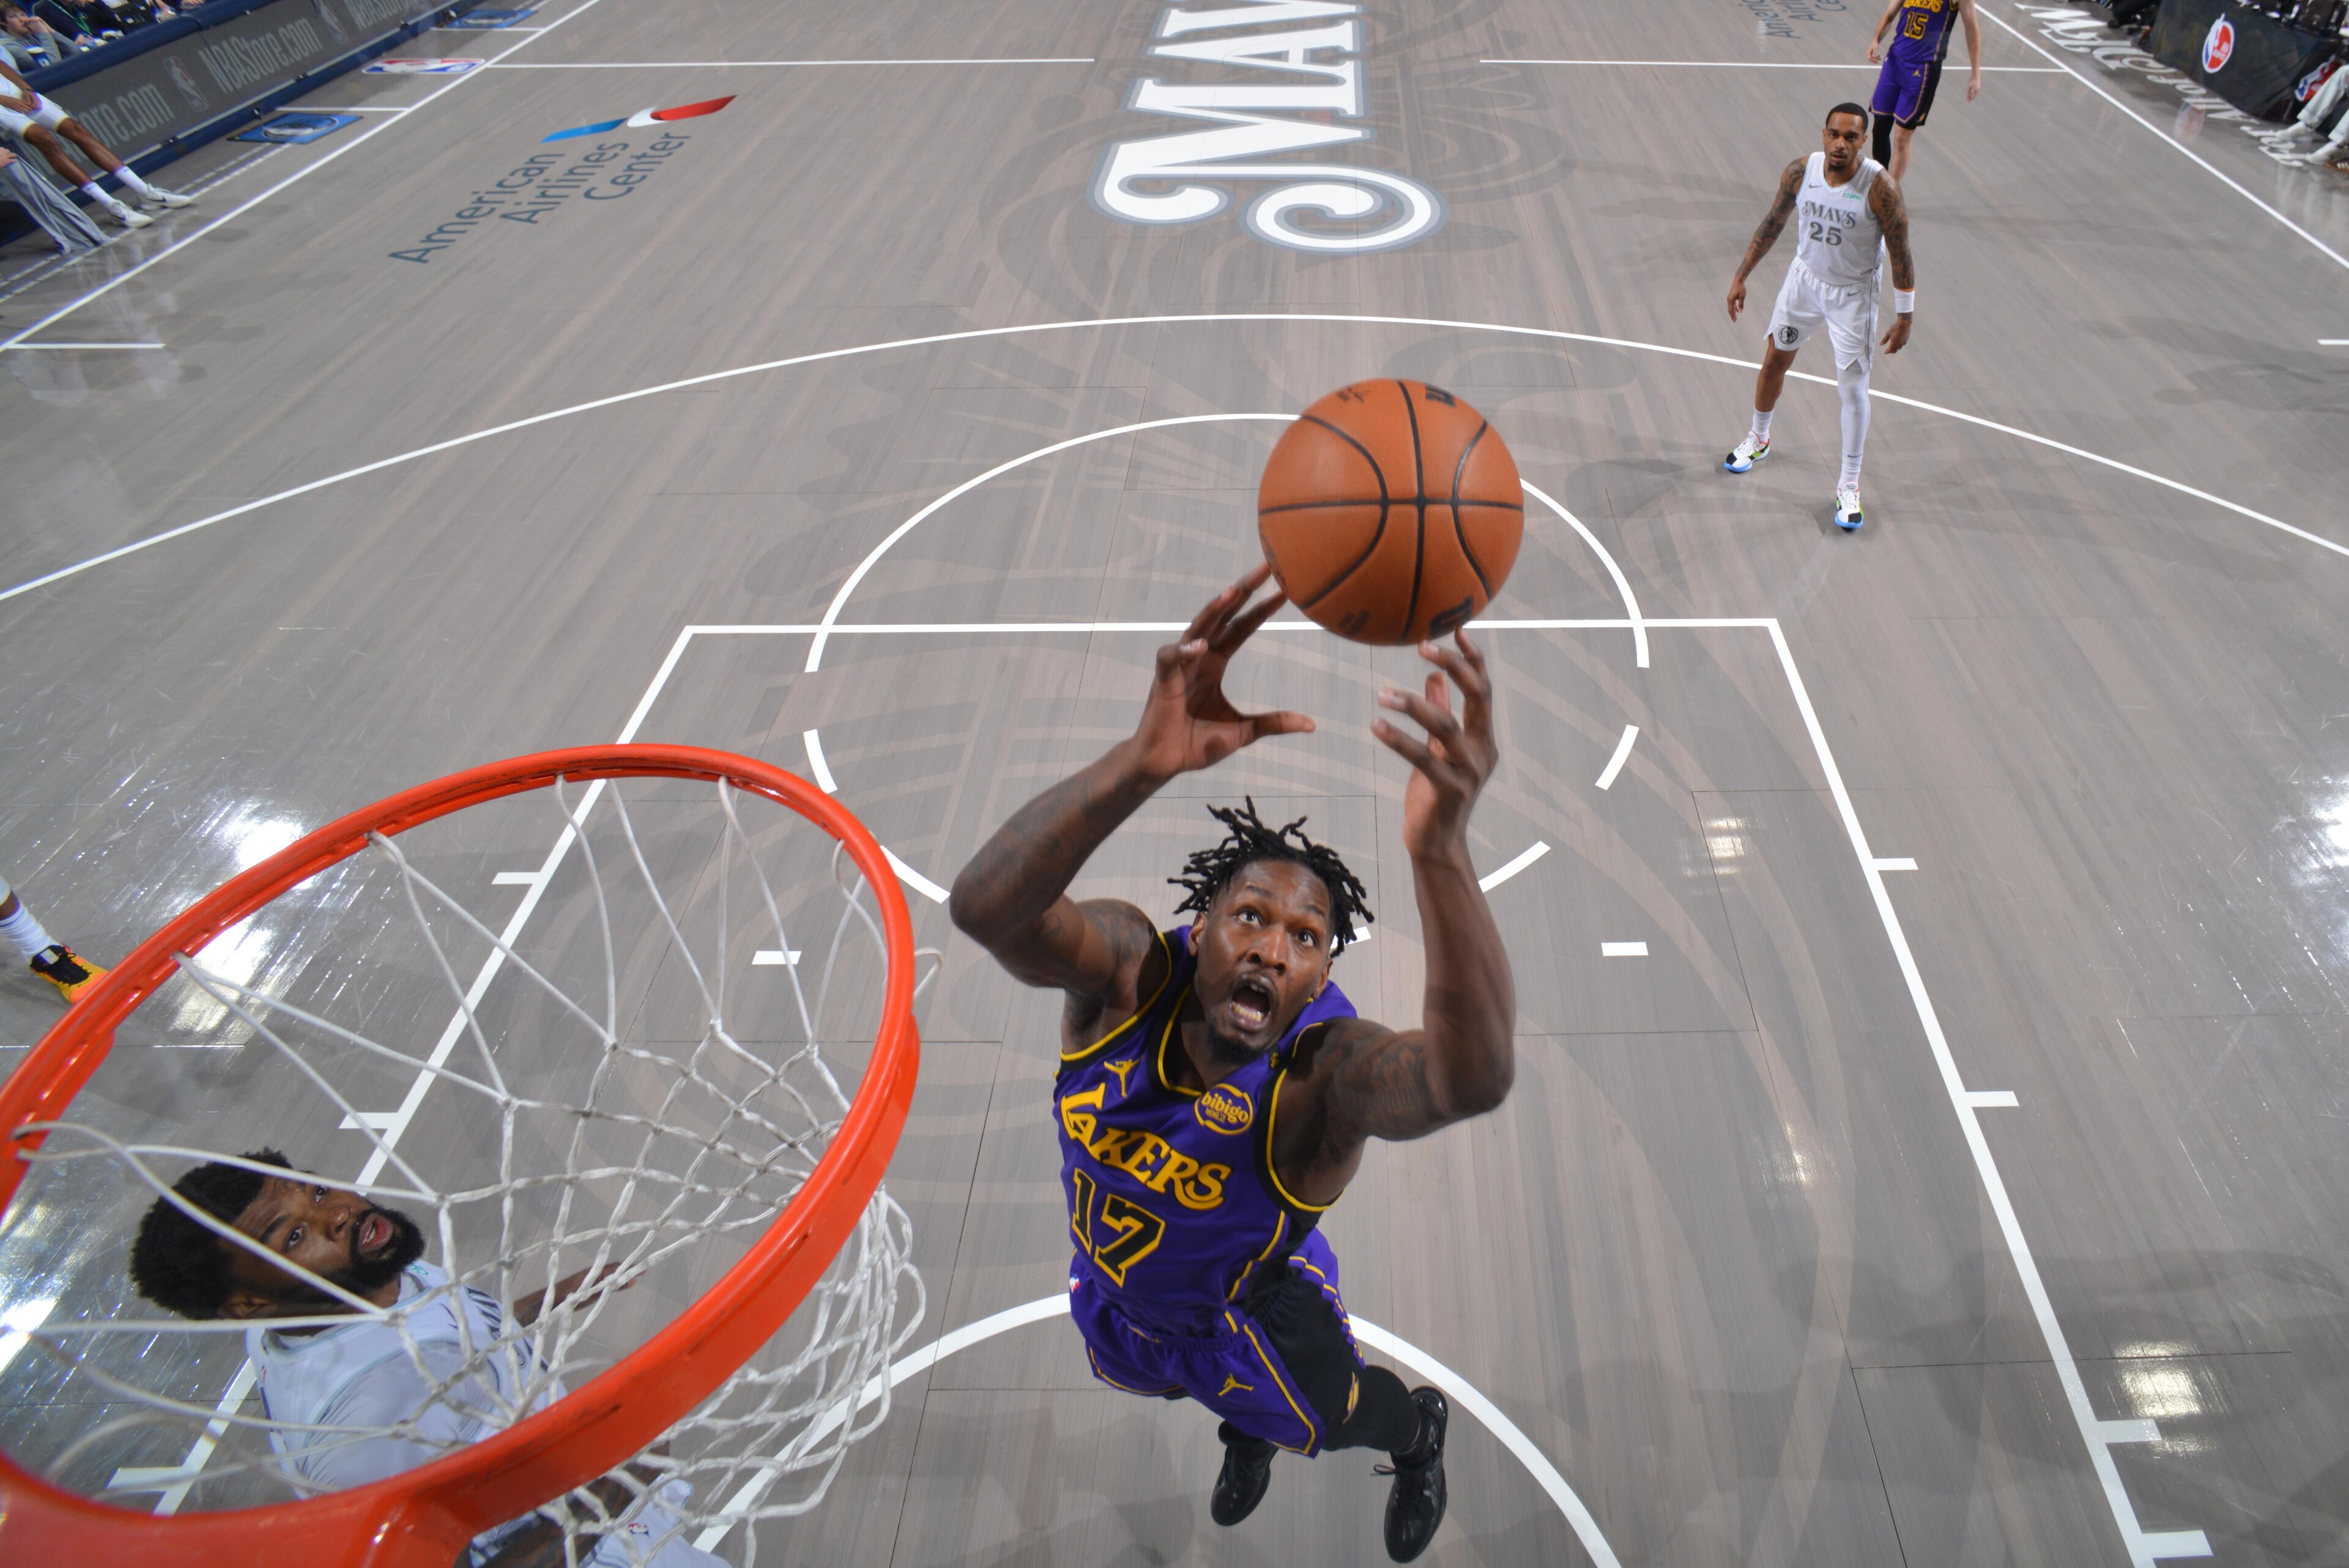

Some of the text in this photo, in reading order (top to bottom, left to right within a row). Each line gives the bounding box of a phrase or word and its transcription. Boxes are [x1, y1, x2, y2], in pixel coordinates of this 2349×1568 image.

[198, 18, 323, 94] NBAStore.com
[1903, 11, 1929, 40] 15
[499, 142, 630, 224] Airlines
[583, 132, 691, 200] Center
[1843, 191, 1861, 201] chime
[387, 153, 566, 264] American
[1802, 201, 1857, 229] MAVS
[1809, 221, 1842, 246] 25
[1201, 1091, 1249, 1124] bibigo
[1061, 1082, 1231, 1210] LAKERS
[1072, 1167, 1165, 1288] 17
